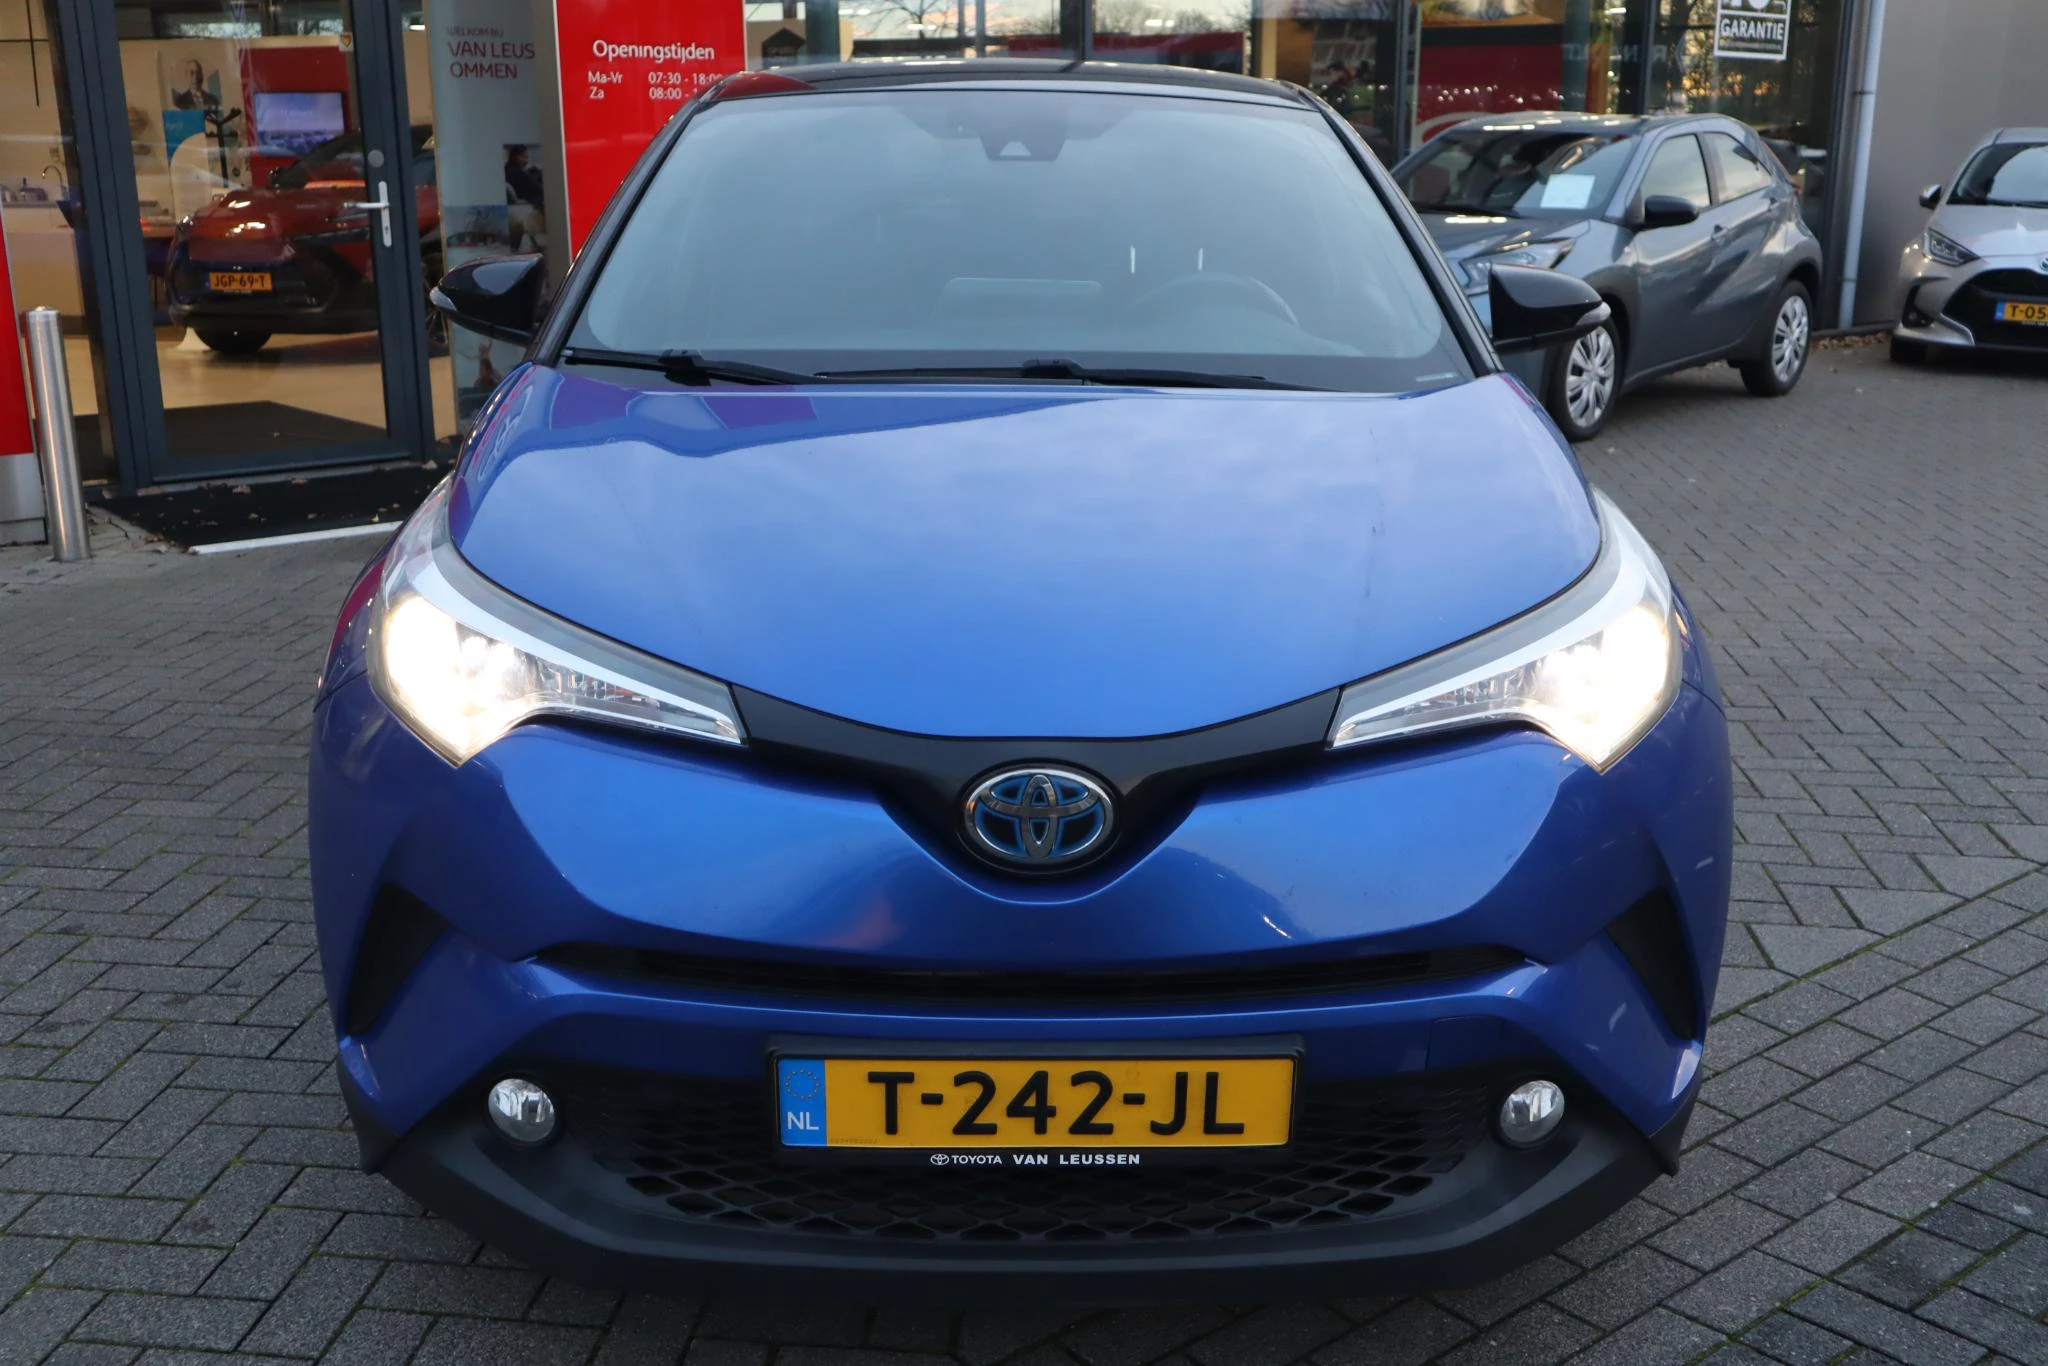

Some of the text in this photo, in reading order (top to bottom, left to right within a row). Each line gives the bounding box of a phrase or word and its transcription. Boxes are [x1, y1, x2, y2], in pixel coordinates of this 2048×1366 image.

[1721, 18, 1785, 40] GARANTIE
[448, 41, 536, 59] VAN LEUS
[593, 39, 715, 64] Openingstijden
[450, 62, 518, 79] OMMEN
[588, 71, 623, 84] Ma-Vr
[648, 72, 681, 85] 07:30
[590, 86, 605, 99] Za
[649, 87, 681, 99] 08:00
[214, 274, 265, 288] JGP-69-T
[868, 1071, 1244, 1135] T-242-JL
[787, 1111, 820, 1130] NL
[951, 1154, 1140, 1165] TOYOTA VAN LEUSSEN
